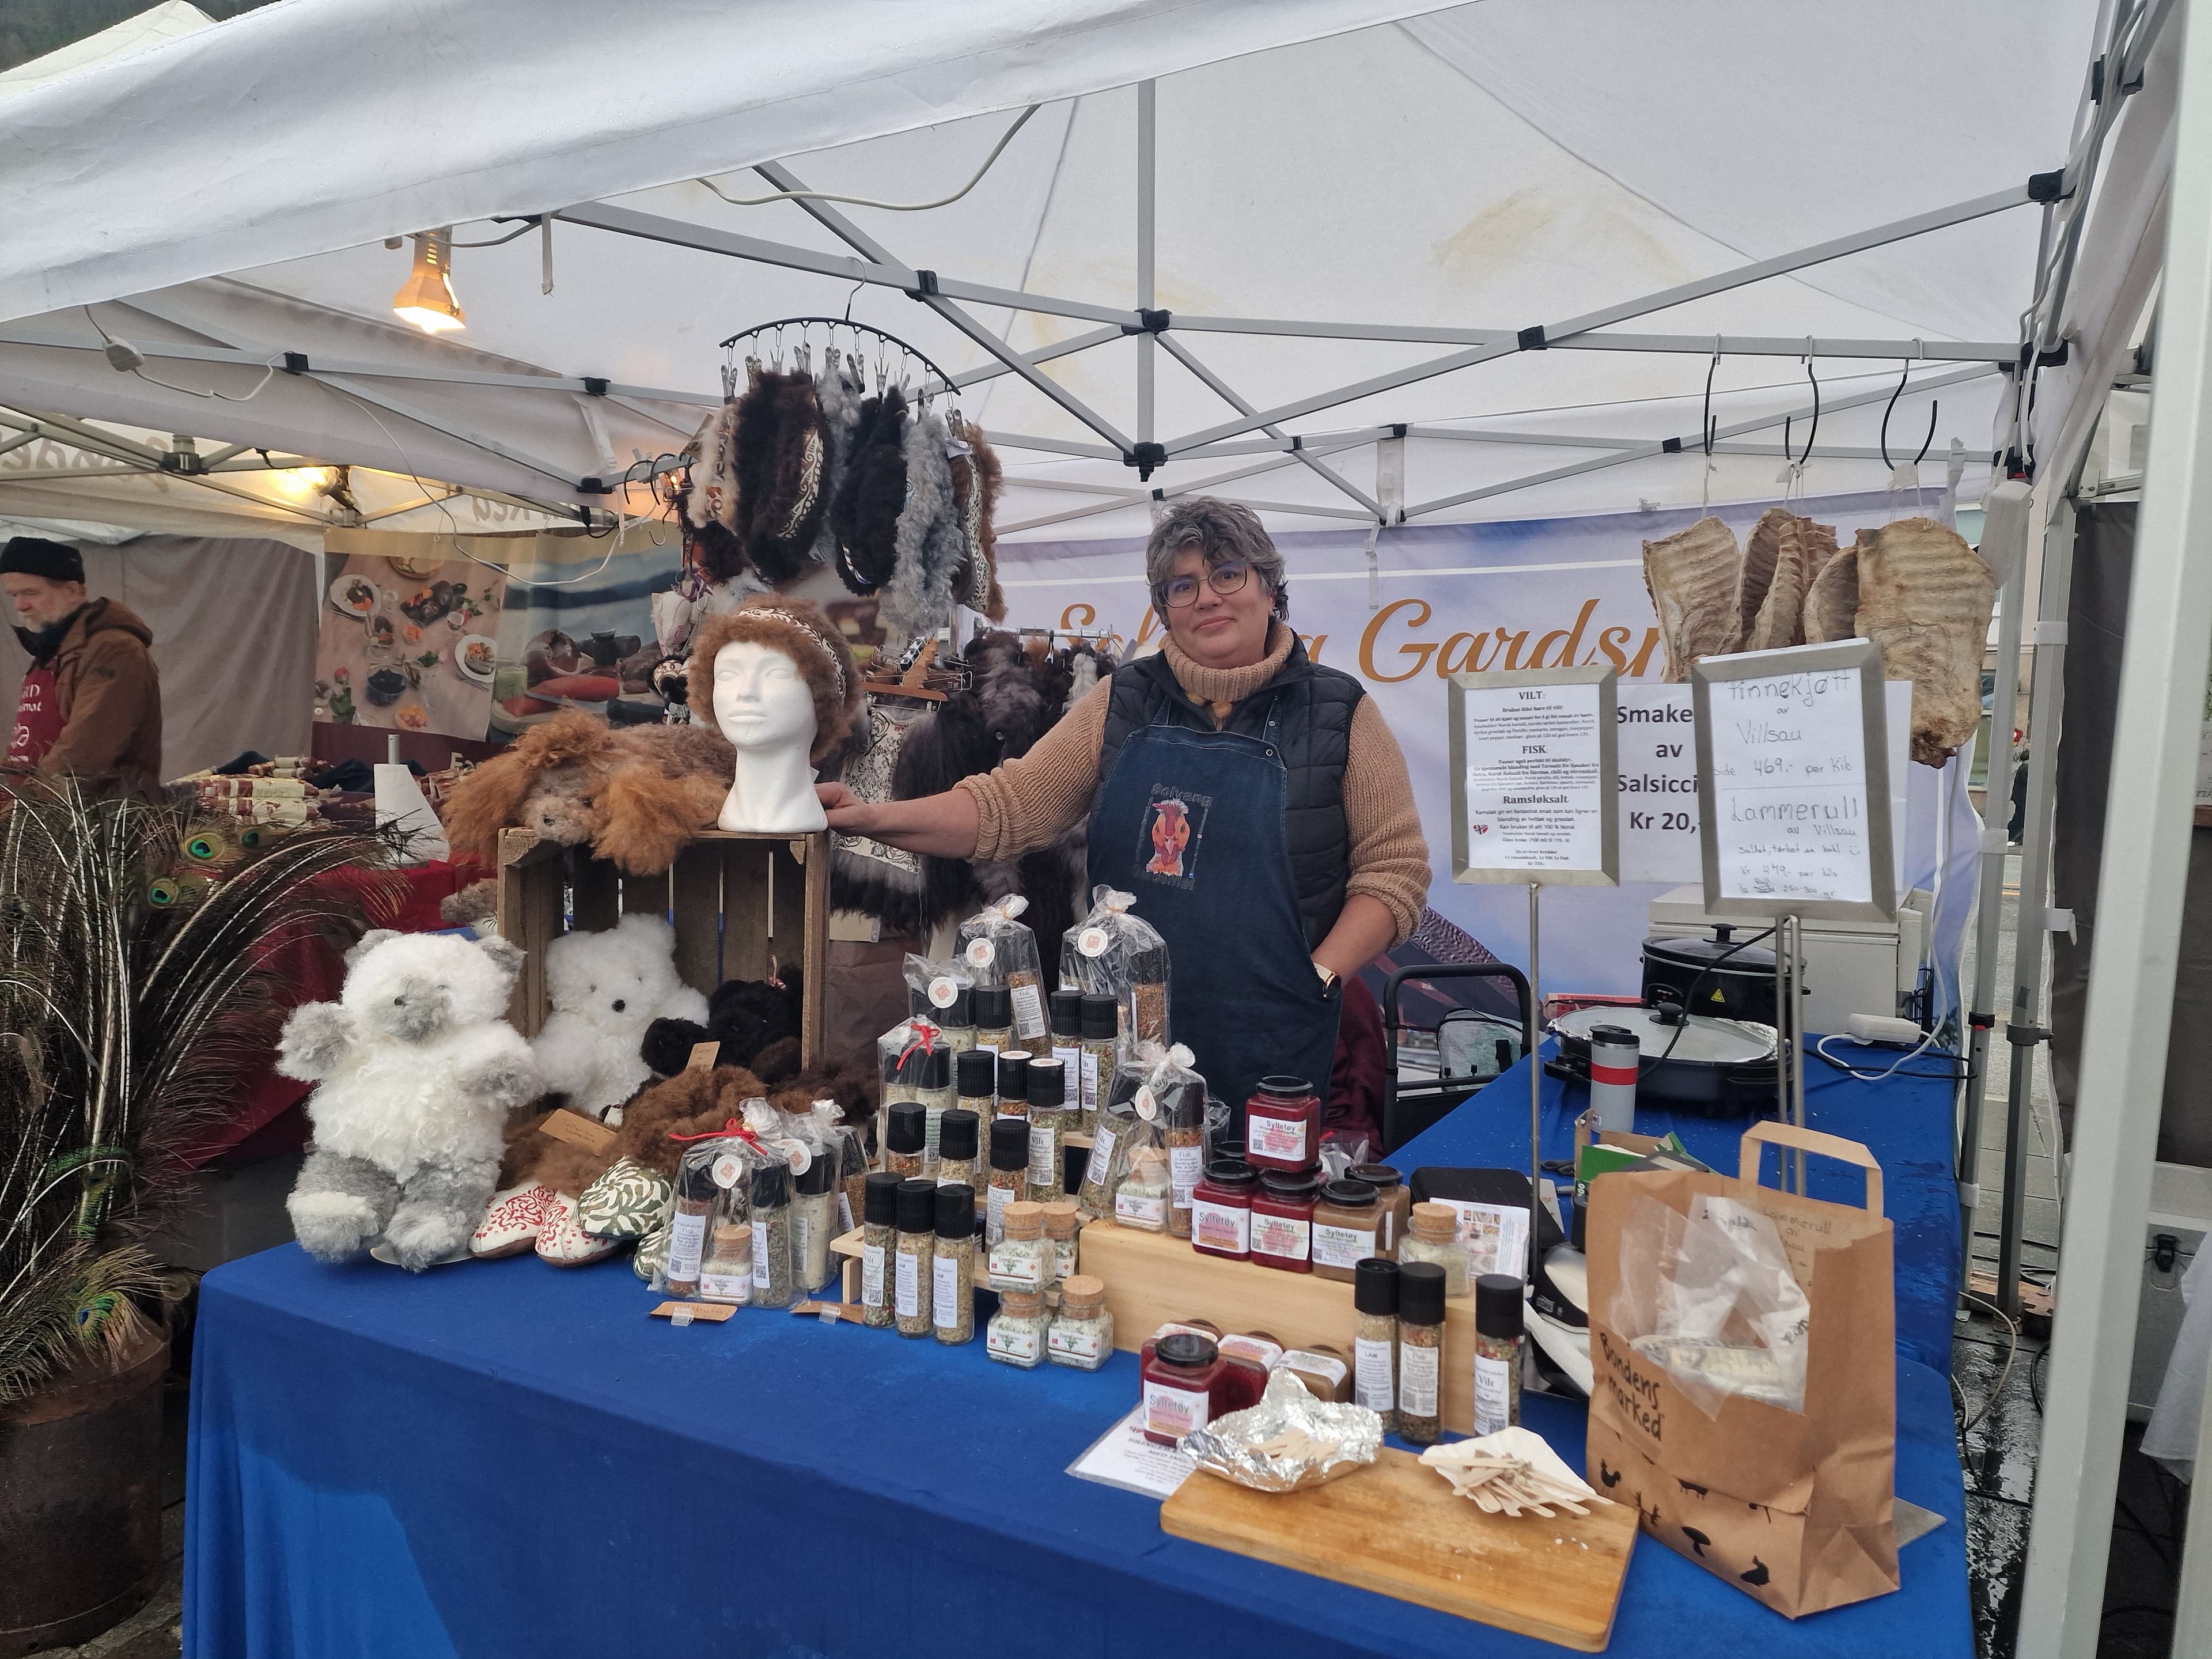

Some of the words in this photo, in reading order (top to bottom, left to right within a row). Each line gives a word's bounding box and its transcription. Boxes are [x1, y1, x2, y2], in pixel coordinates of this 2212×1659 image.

[1518, 691, 1546, 700] VILT:
[1618, 704, 1694, 724] Smake
[1736, 719, 1801, 744] Villsau
[1656, 744, 1683, 758] av
[1806, 766, 1824, 777] per
[1732, 795, 1858, 821] Lammerull
[1630, 812, 1654, 830] Kr
[1787, 826, 1799, 835] av
[1814, 824, 1858, 835] Villsau
[1266, 1120, 1296, 1134] Syltetøy
[1031, 1136, 1044, 1145] Vilt
[1199, 1211, 1235, 1228] Syltetøy
[1264, 1218, 1295, 1233] Syltetøy
[1325, 1228, 1358, 1243] Syltetøy
[1600, 1332, 1660, 1411] Bondens
[1150, 1395, 1190, 1415] Syltetøy
[1608, 1372, 1661, 1441] marked
